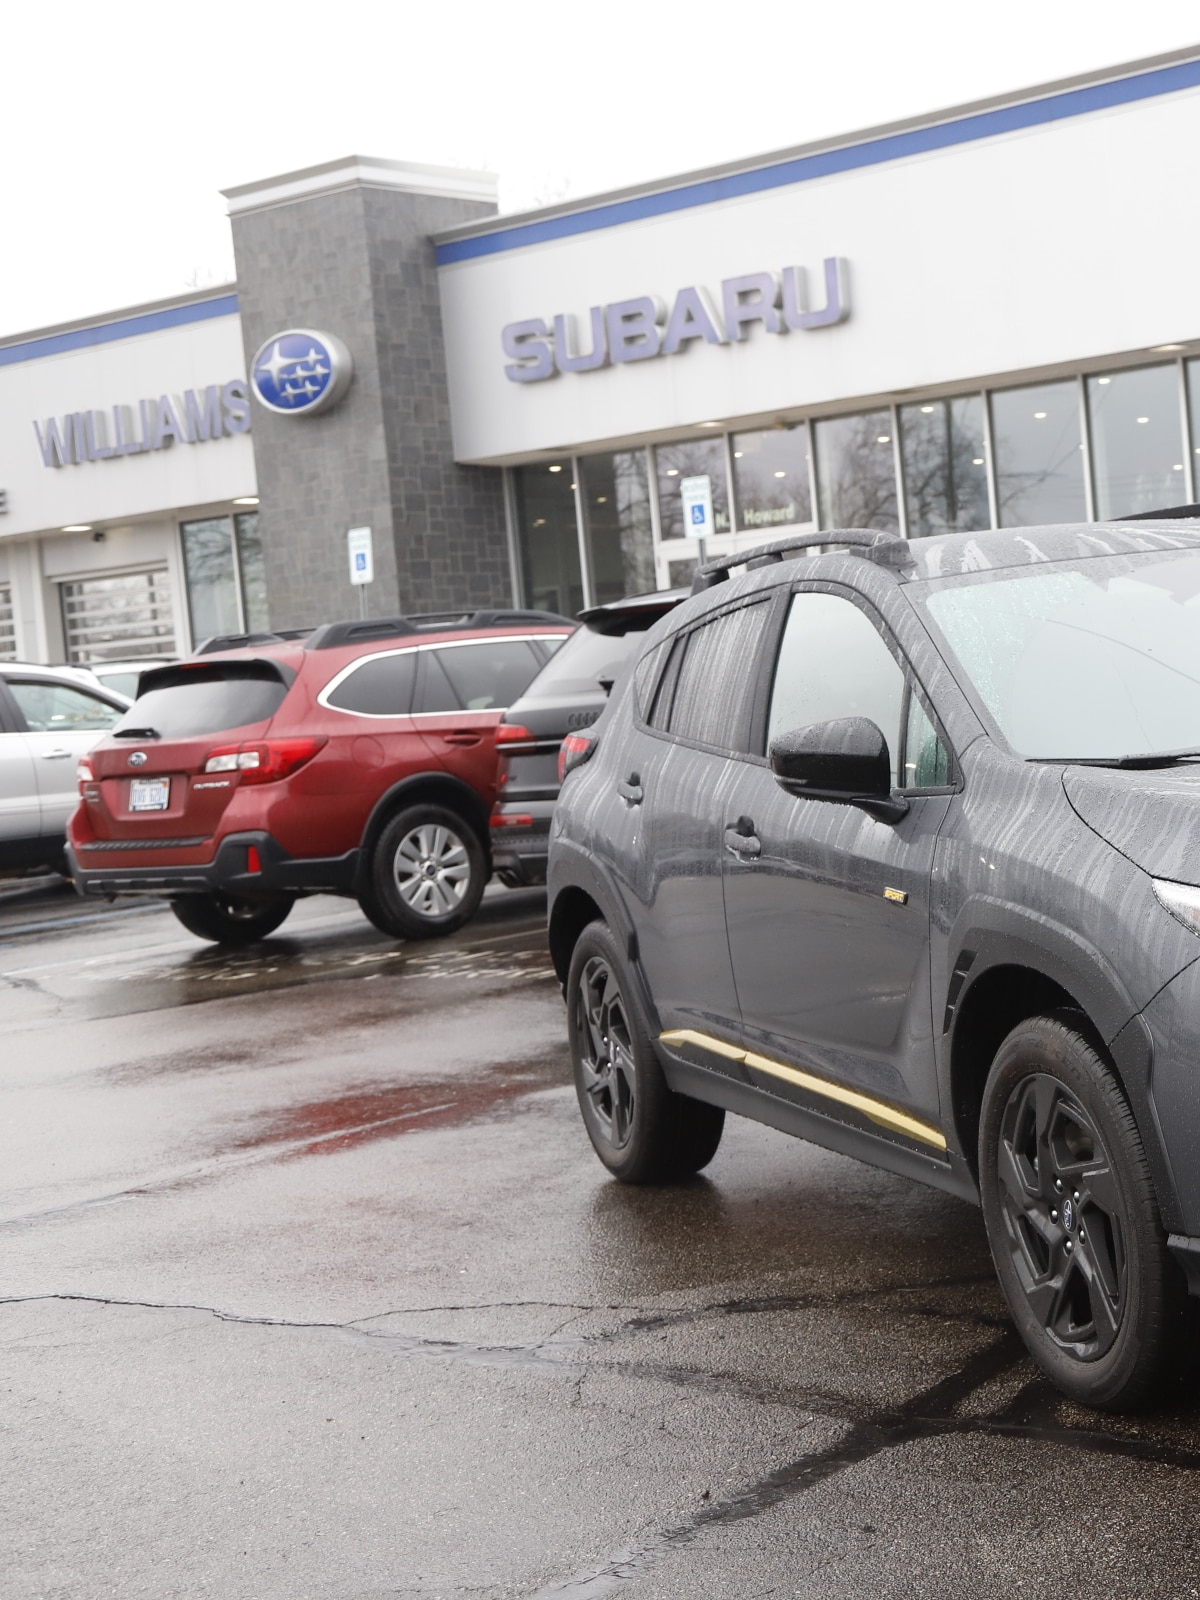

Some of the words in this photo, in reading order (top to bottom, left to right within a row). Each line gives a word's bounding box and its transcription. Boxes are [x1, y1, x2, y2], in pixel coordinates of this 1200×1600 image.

[502, 256, 850, 384] SUBARU
[33, 379, 250, 467] WILLIAMS
[744, 503, 795, 525] Howard
